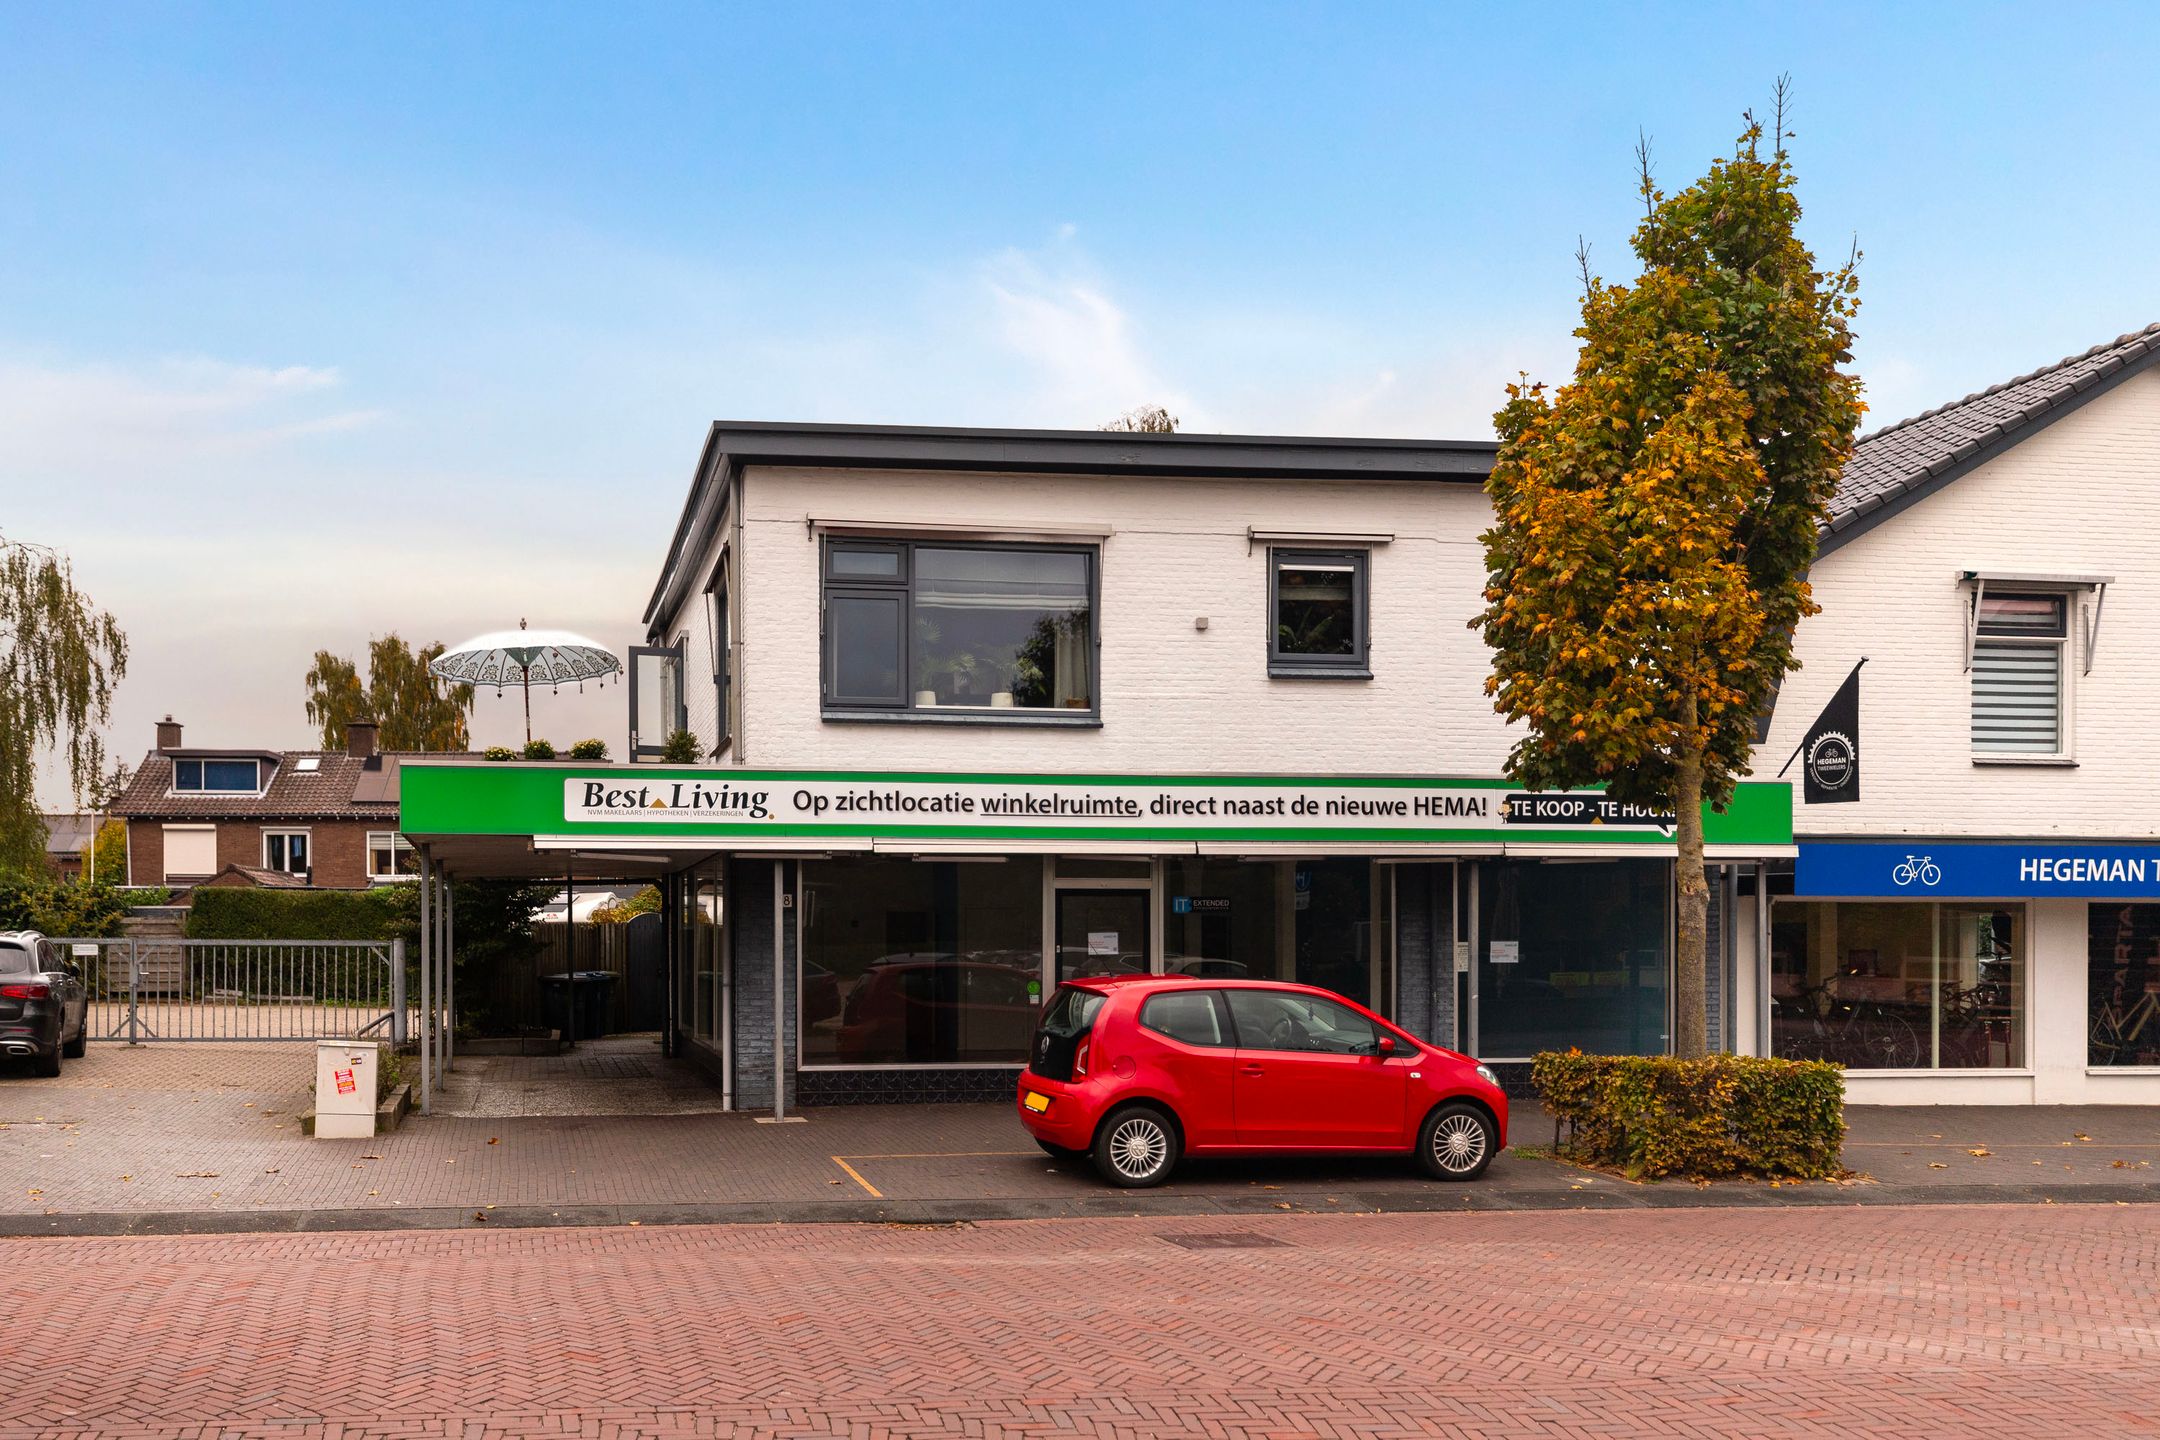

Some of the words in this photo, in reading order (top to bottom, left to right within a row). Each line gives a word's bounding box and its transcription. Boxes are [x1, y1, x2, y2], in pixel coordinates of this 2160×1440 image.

[1817, 757, 1847, 766] HEGEMAN
[582, 782, 650, 808] Best
[794, 790, 829, 816] Op
[836, 790, 975, 813] zichtlocatie
[981, 793, 1143, 817] winkelruimte,
[1150, 794, 1217, 815] direct
[1224, 796, 1285, 815] naast
[1291, 795, 1320, 815] de
[1327, 795, 1408, 815] nieuwe
[1414, 797, 1488, 816] HEMA!
[1511, 801, 1532, 816] TE
[1536, 801, 1585, 817] KOOP
[1598, 802, 1618, 817] TE
[693, 810, 744, 818] VERZEKERINGEN
[2020, 859, 2145, 882] HEGEMAN
[1175, 898, 1189, 912] IT
[1193, 899, 1230, 907] EXTENDED
